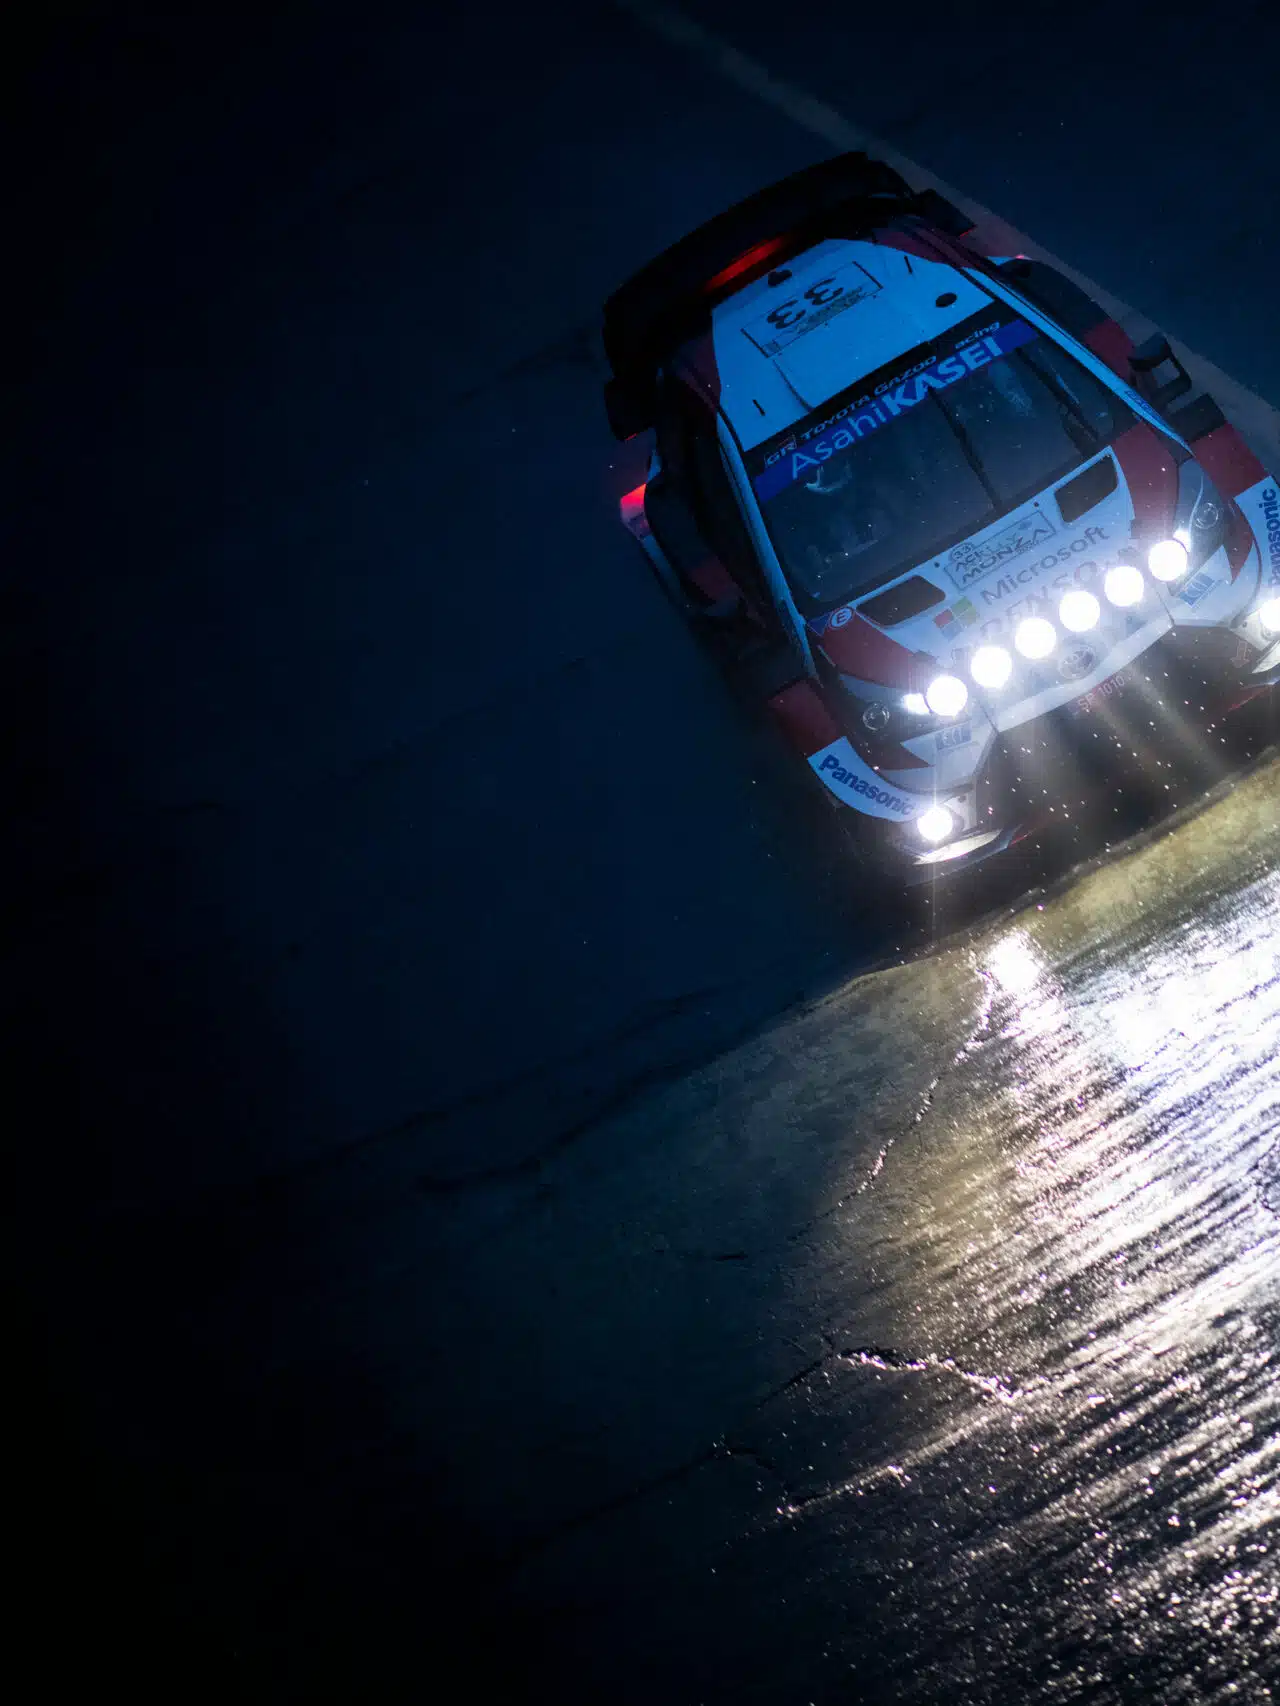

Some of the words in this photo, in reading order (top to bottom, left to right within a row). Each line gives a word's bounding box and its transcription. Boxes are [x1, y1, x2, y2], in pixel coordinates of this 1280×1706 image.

[766, 277, 844, 330] 33
[801, 394, 870, 441] TOYOTA
[953, 544, 973, 560] 33
[962, 528, 1049, 584] MONZA
[980, 525, 1111, 605] Microsoft
[819, 754, 915, 816] Panasonic
